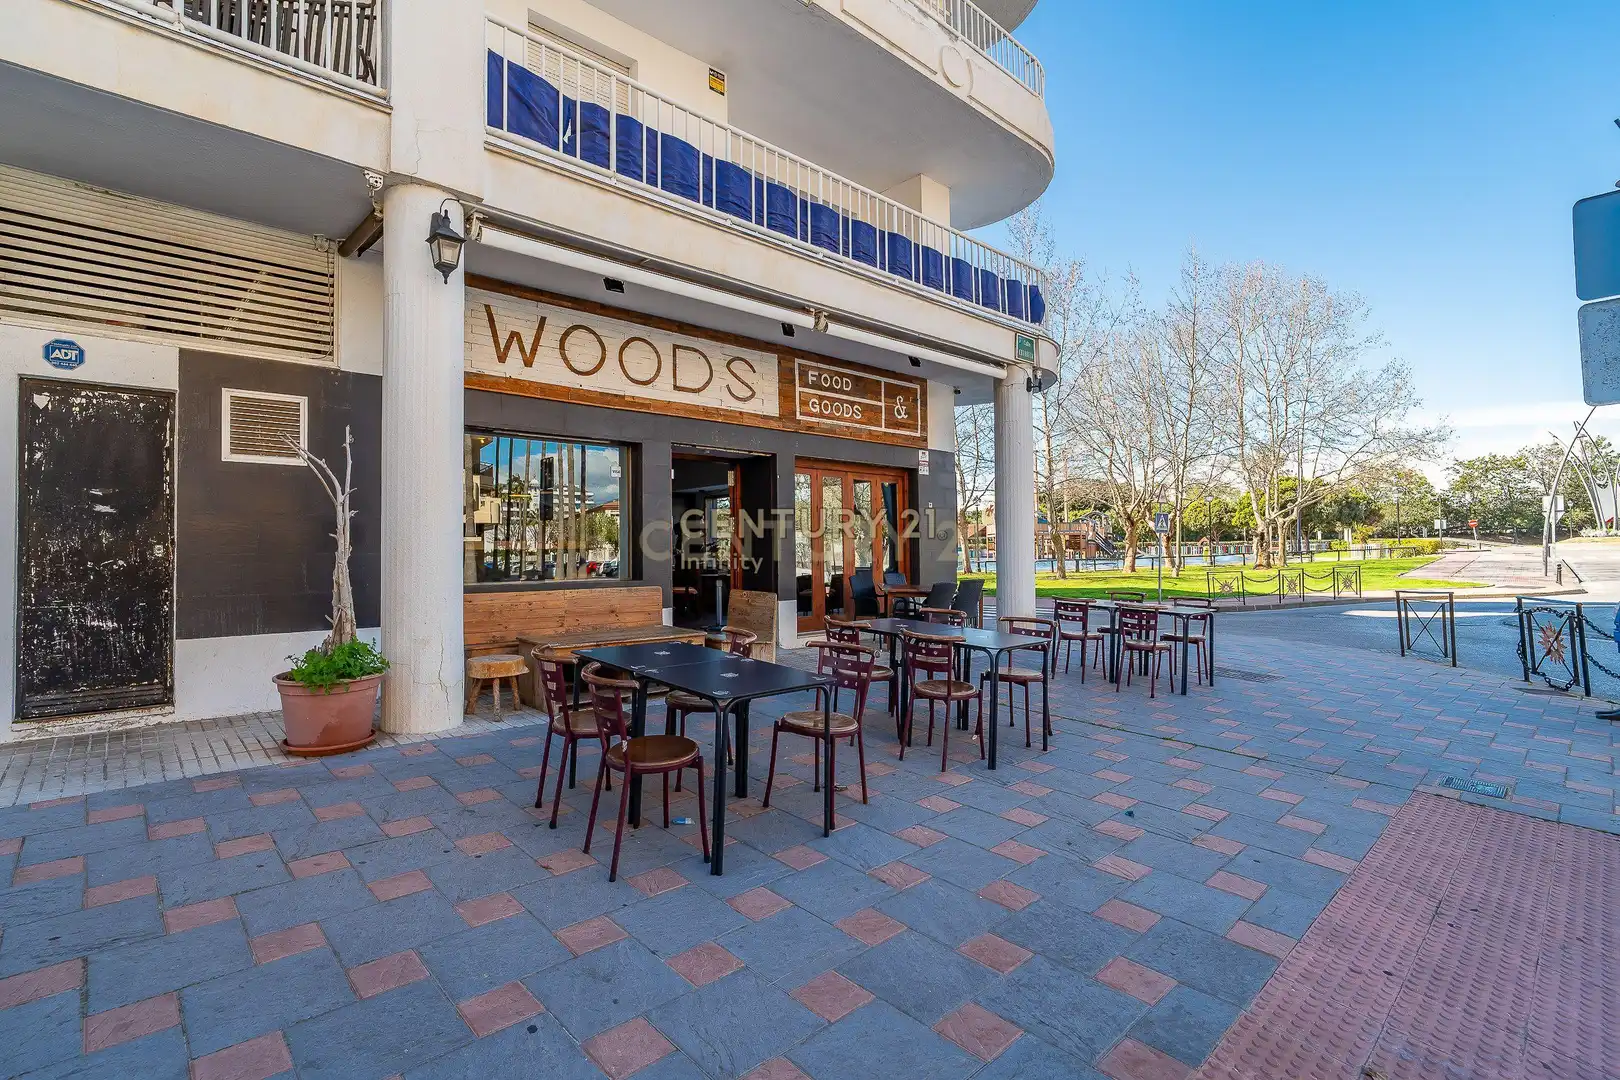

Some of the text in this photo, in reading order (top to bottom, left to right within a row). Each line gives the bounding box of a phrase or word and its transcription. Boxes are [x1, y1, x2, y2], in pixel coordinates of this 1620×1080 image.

[50, 348, 79, 361] ADT
[484, 304, 756, 402] WOODS
[808, 371, 852, 391] FOOD
[809, 398, 862, 419] GOODS
[894, 396, 908, 419] &
